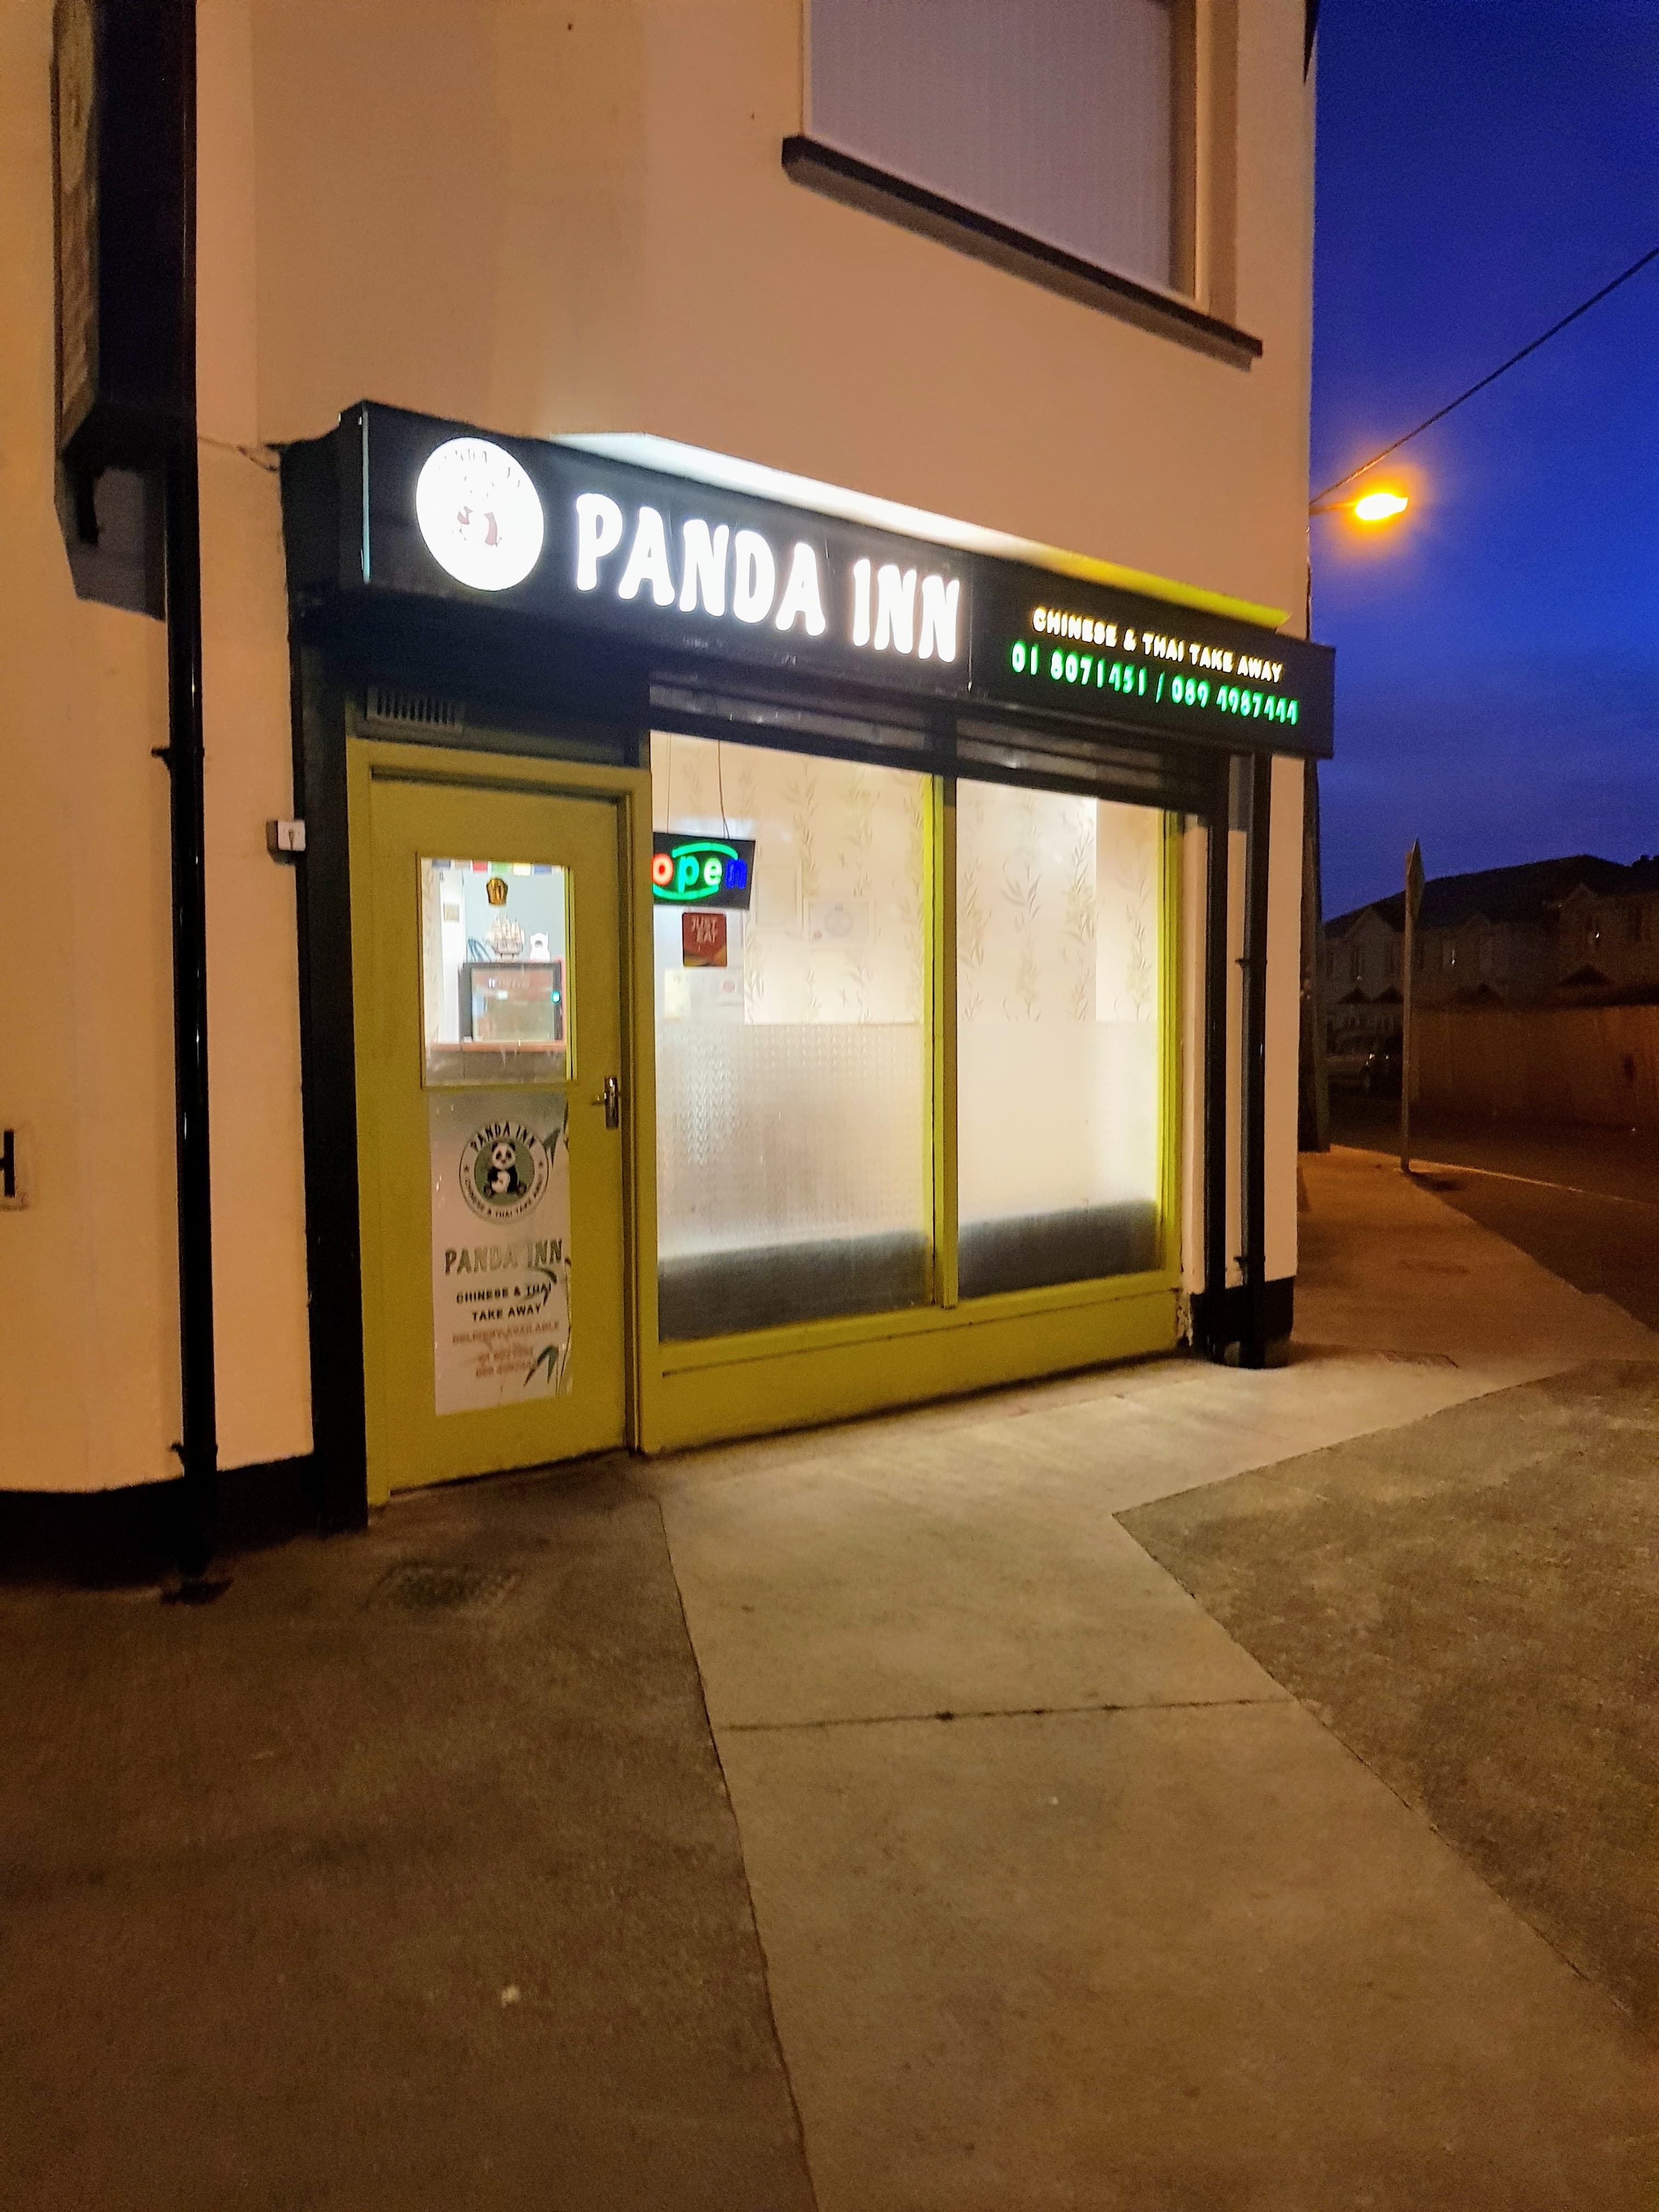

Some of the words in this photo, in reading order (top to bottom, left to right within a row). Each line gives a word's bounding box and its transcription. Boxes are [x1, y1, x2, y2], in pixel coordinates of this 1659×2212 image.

[575, 493, 826, 636] PANDA
[853, 558, 960, 663] INN
[1033, 606, 1118, 647] CHINESE
[1123, 628, 1137, 651] &
[1142, 632, 1184, 662] THAI
[1189, 643, 1233, 673] TAKE
[1237, 655, 1283, 682] AWAY
[1012, 640, 1039, 675] 01
[1050, 649, 1147, 696] 8071451
[1171, 674, 1210, 708] 089
[651, 854, 747, 893] open
[445, 1248, 518, 1276] PANDA
[527, 1238, 562, 1268] INN
[456, 1287, 509, 1304] CHINESE
[472, 1309, 503, 1322] TAKE
[508, 1304, 540, 1318] AWAY
